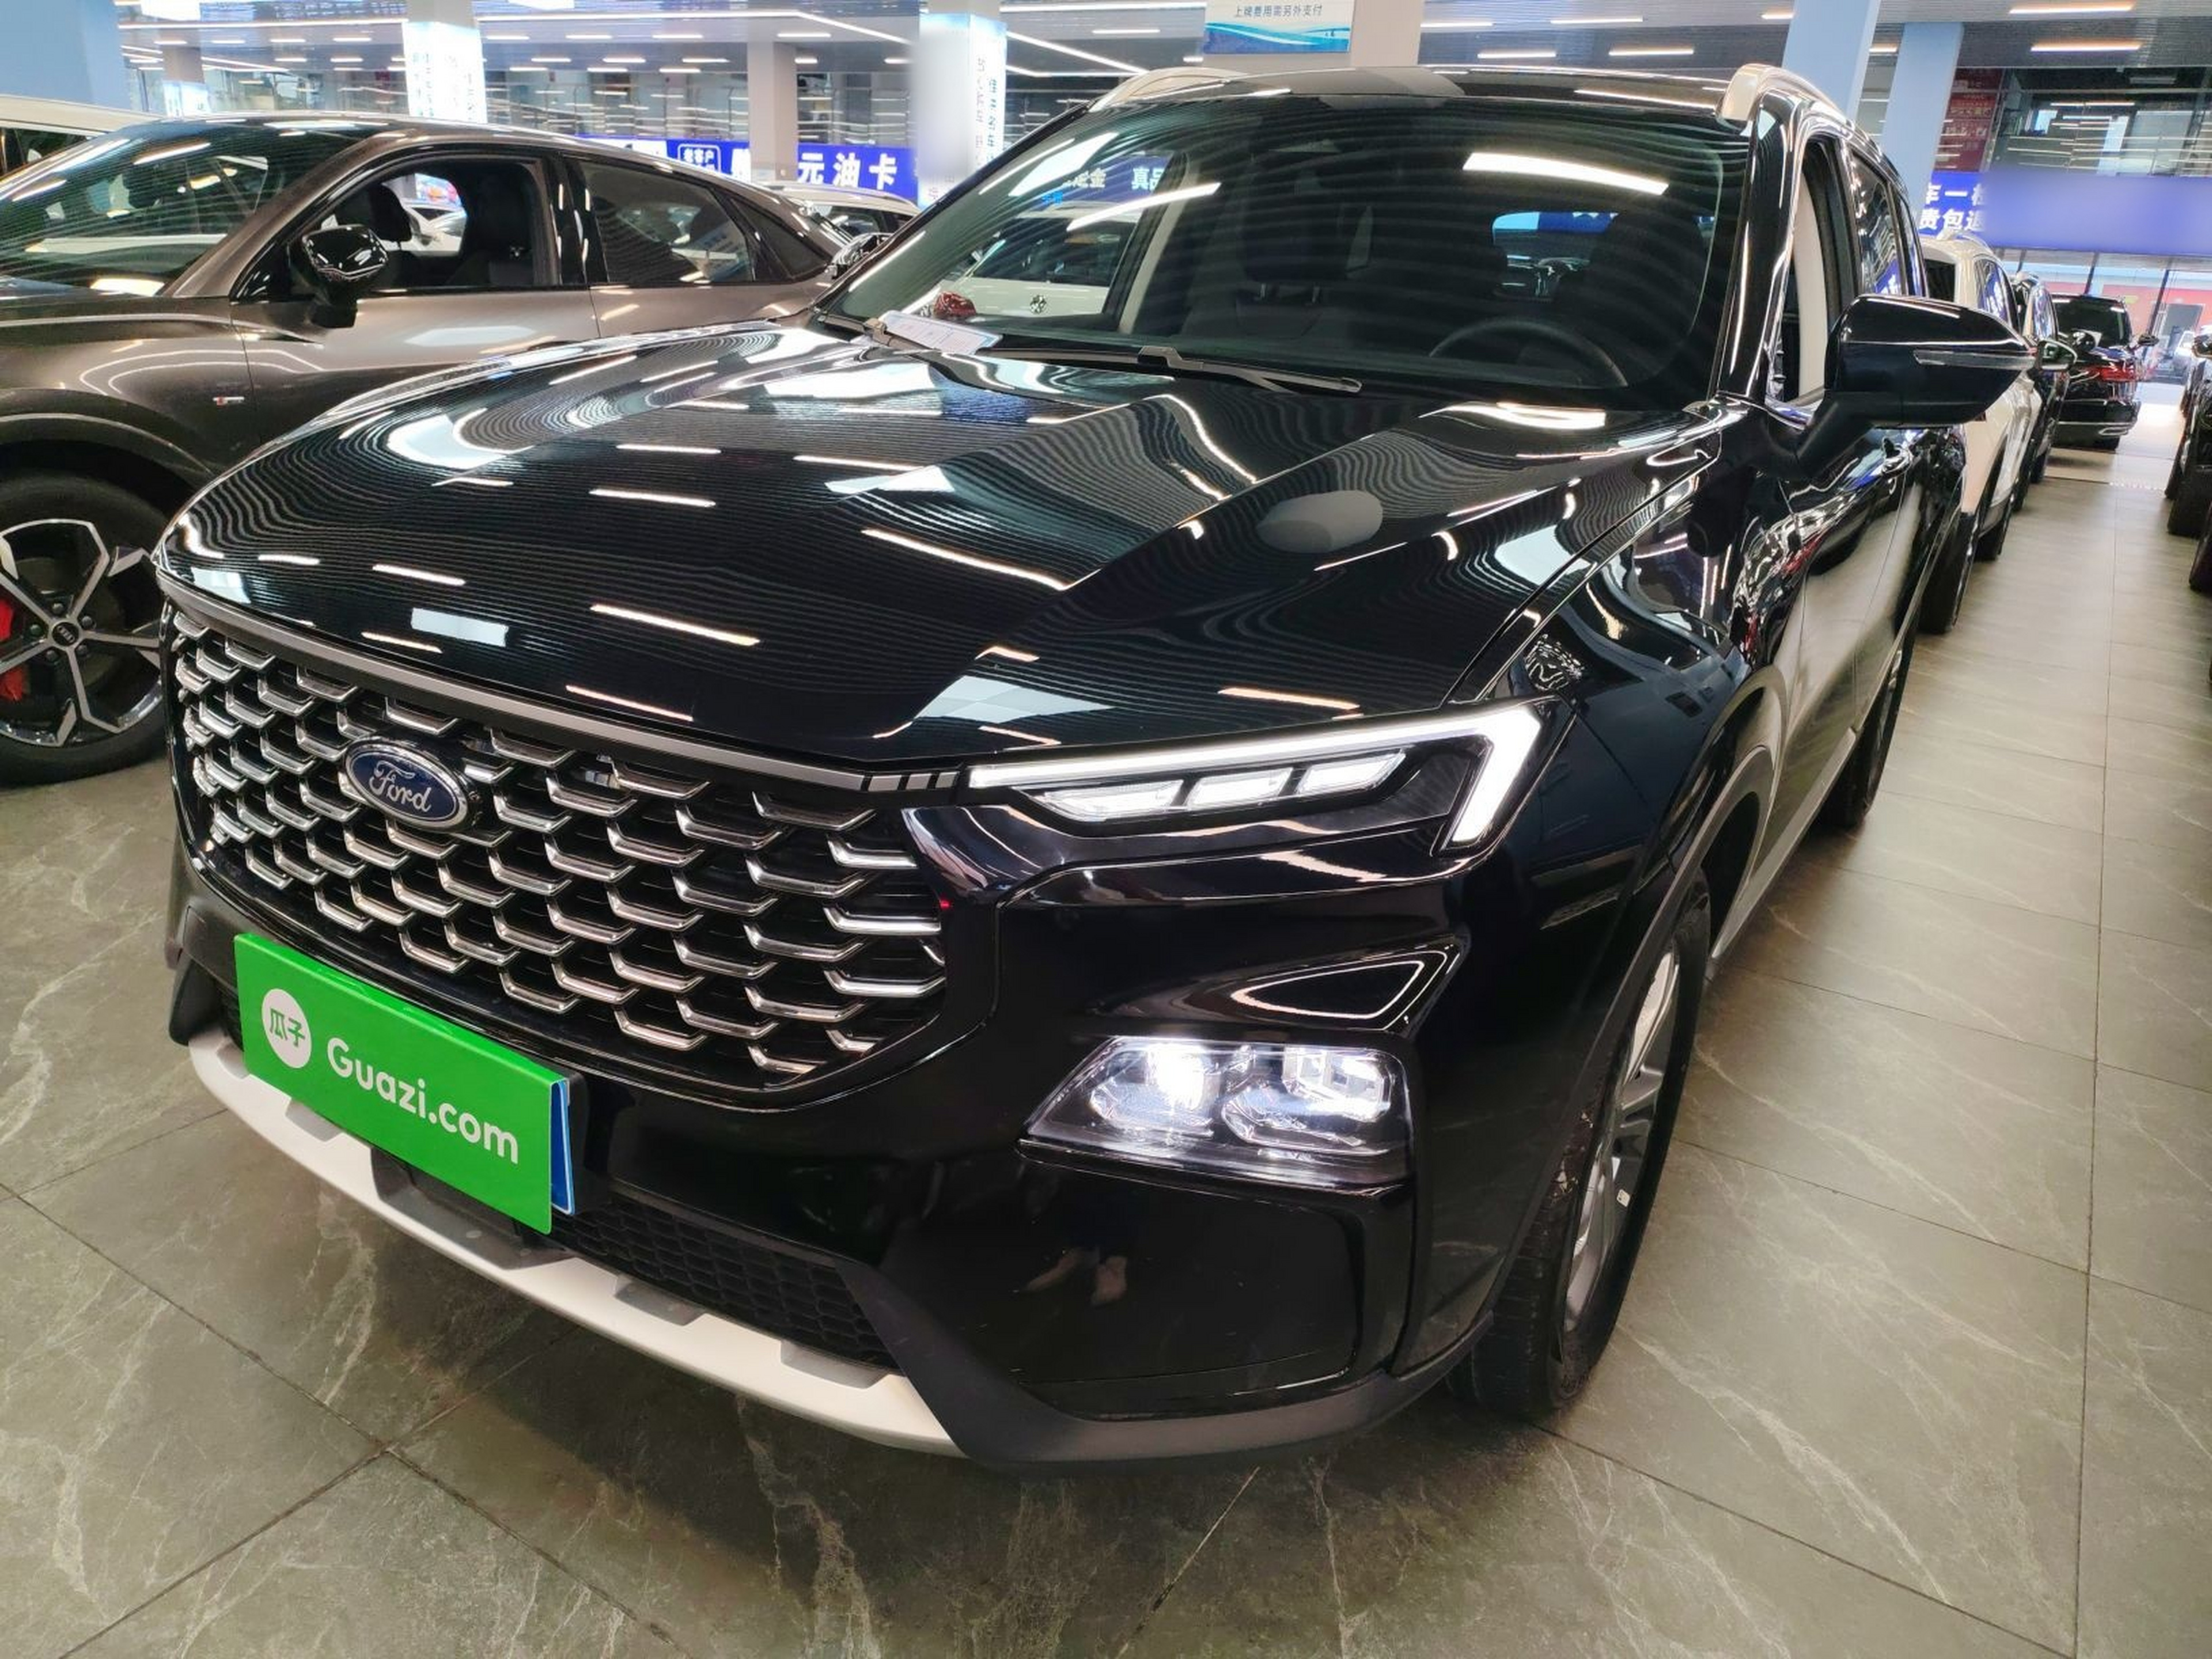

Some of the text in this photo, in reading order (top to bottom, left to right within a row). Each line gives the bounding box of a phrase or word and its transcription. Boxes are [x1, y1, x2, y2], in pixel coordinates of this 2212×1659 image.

[798, 152, 897, 190] 元油卡
[369, 760, 432, 812] Ford
[268, 1007, 306, 1047] 瓜子
[327, 1037, 519, 1164] Guazi.com
